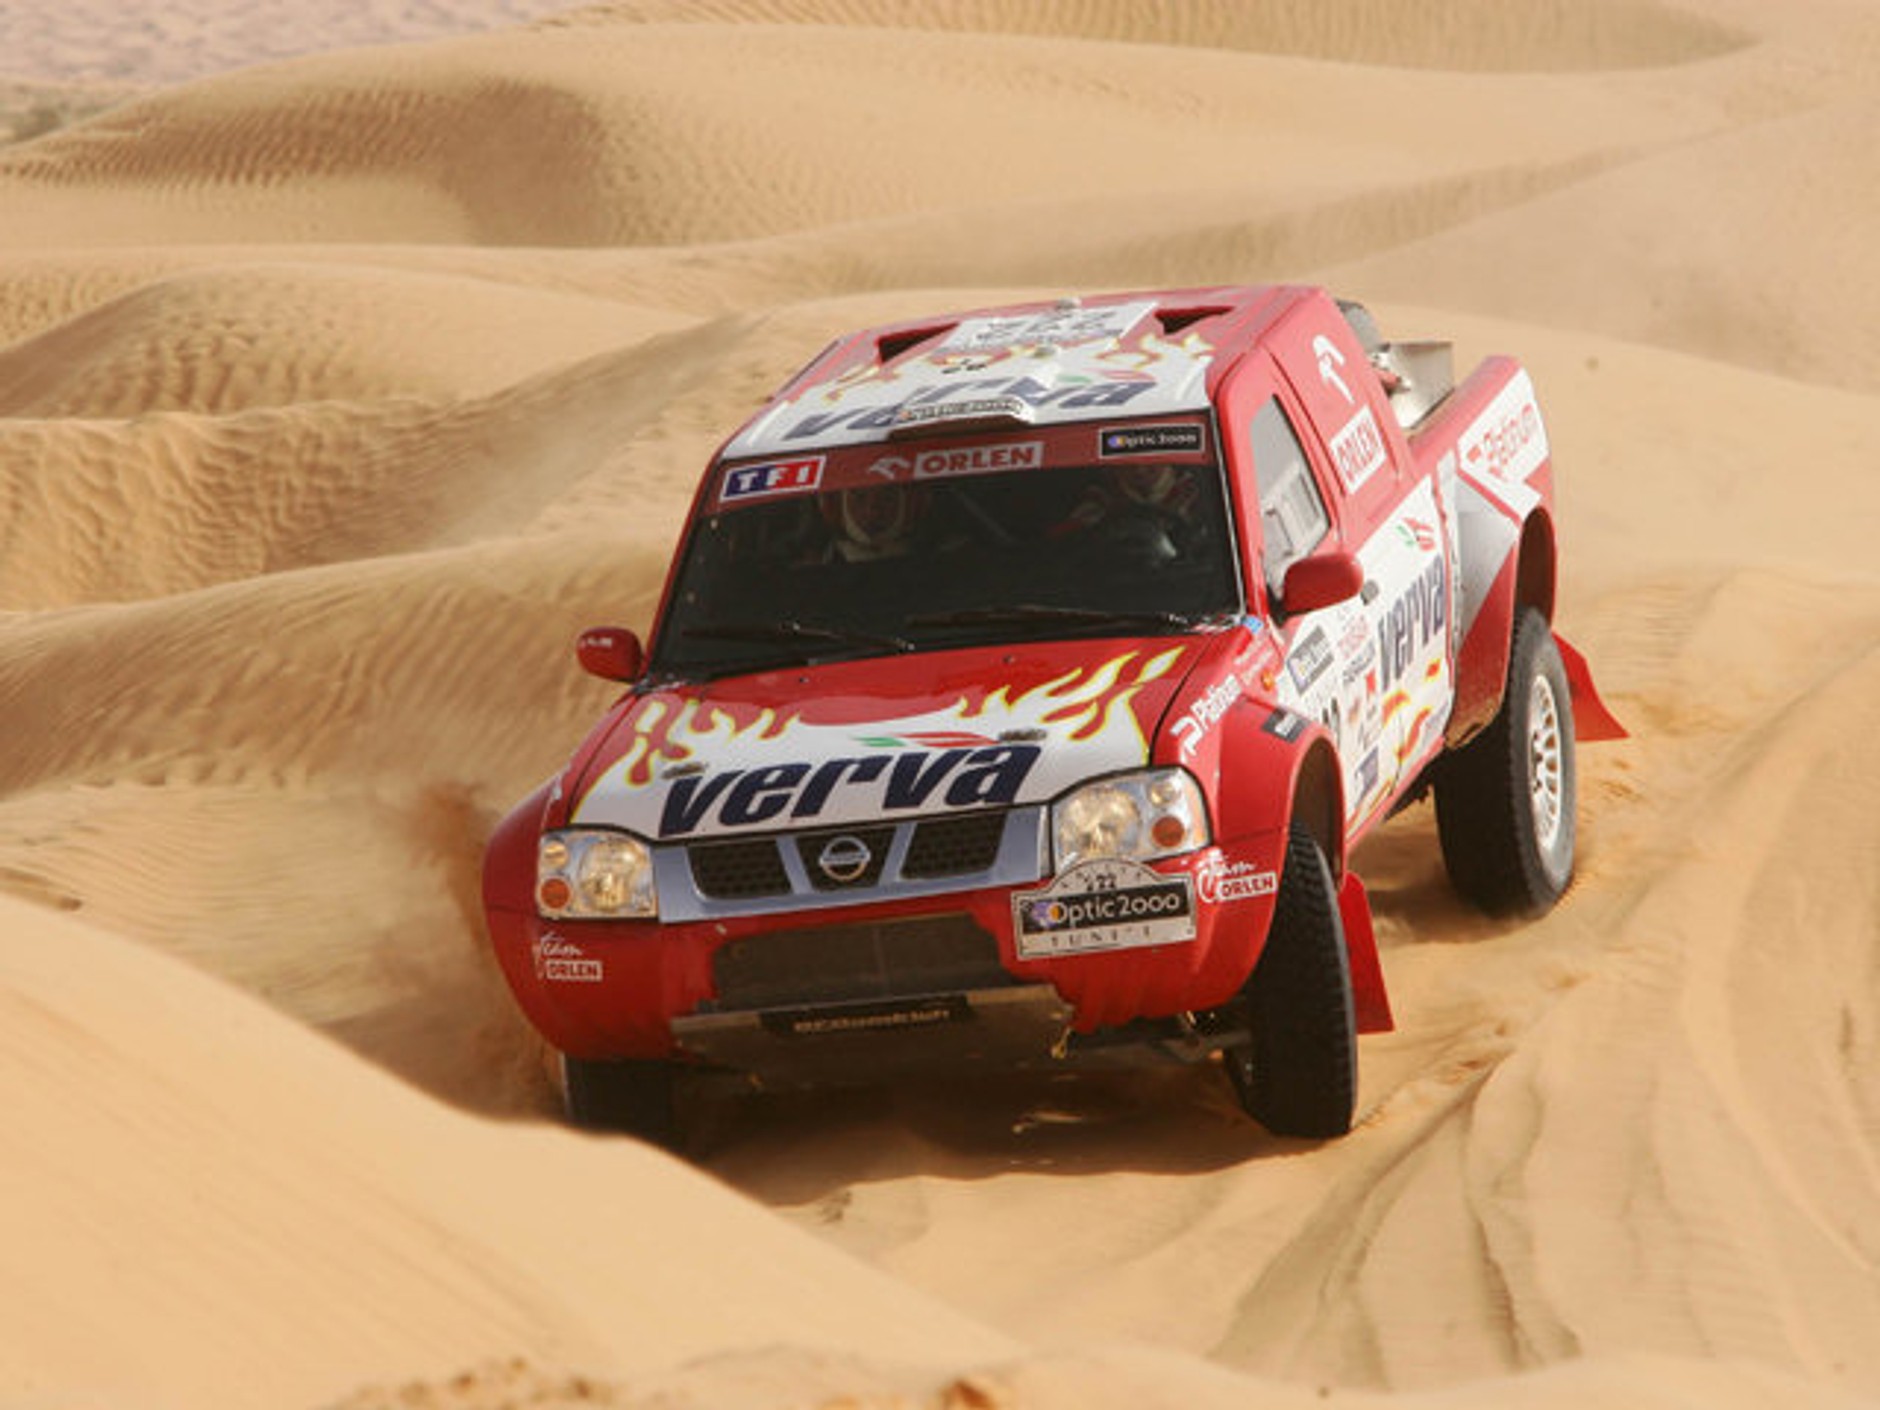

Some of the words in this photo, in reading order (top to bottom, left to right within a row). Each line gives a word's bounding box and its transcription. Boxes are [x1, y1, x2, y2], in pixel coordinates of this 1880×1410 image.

[922, 446, 1034, 473] ORLEN
[1337, 417, 1380, 483] ORLEN
[734, 463, 814, 493] TF1
[1378, 552, 1443, 691] verva
[660, 746, 1041, 836] verva
[1221, 876, 1273, 897] ORLEN
